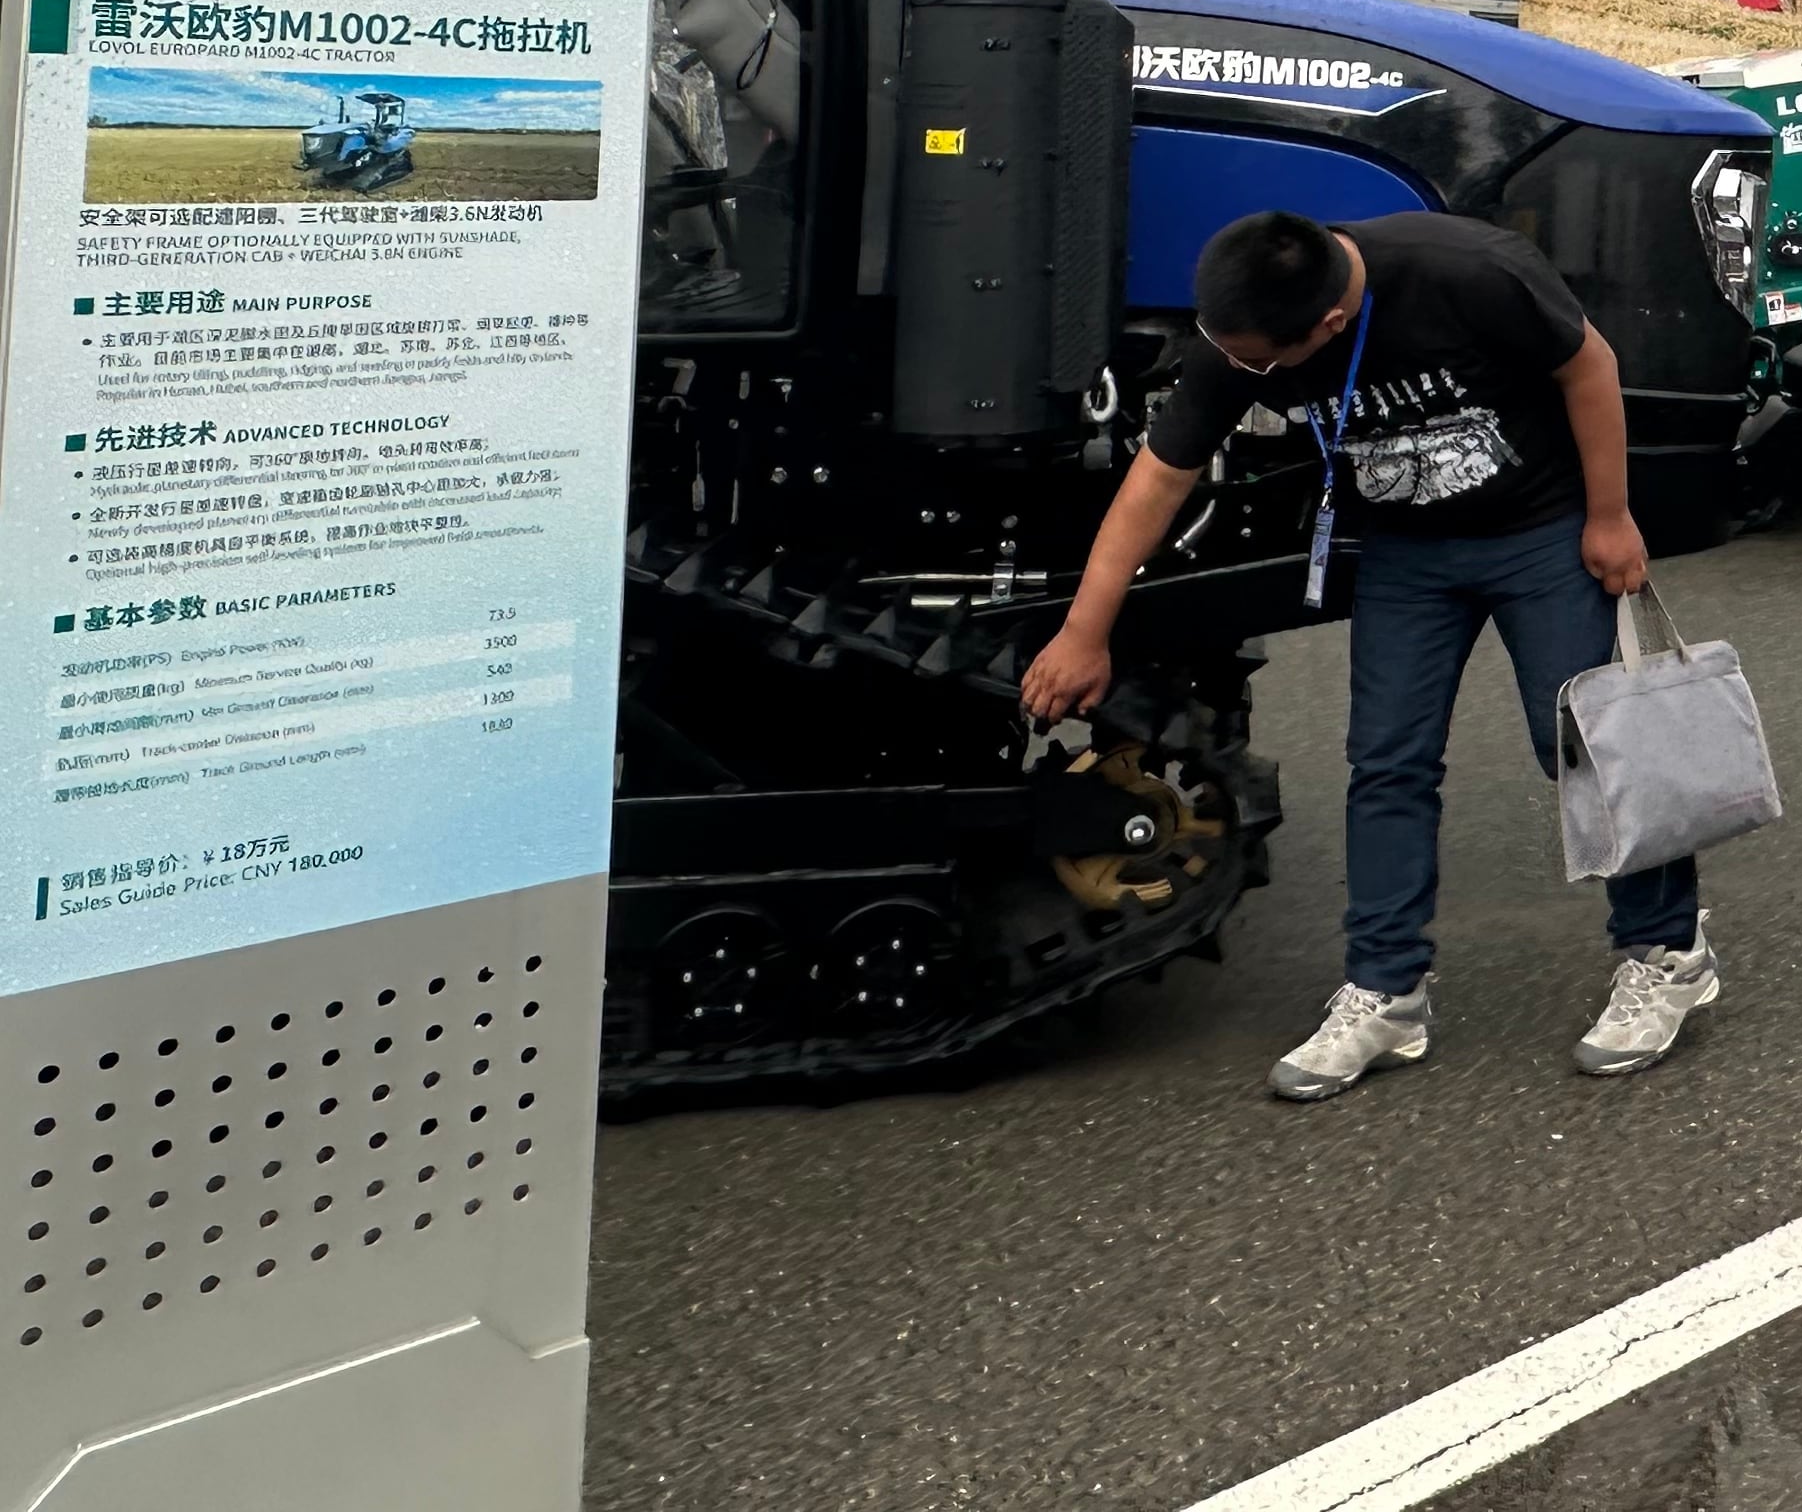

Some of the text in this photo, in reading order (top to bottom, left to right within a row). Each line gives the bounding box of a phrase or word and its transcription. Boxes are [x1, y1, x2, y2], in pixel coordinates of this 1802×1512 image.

[89, 40, 395, 63] LOVOL EUROPARD M1002-4C TRACTOR
[1133, 45, 1403, 89] 沃欧豹M1002-4C
[77, 237, 141, 250] SAFETY
[146, 236, 202, 249] FRAME
[208, 235, 309, 248] OPTIONALLY
[314, 233, 392, 247] EQUIPPED
[397, 232, 434, 245] WITH
[78, 251, 246, 266] THIRD-GENERATION
[252, 250, 283, 263] CAB
[301, 248, 366, 262] WEICHAI
[408, 246, 463, 260] ENGINE
[102, 288, 372, 316] 主要用途 MAIN PURPOSE
[95, 414, 449, 452] 先进技术 ADVANCED TECHNOLOGY
[84, 583, 396, 632] 基本参数 BASIC PARAMETERS
[59, 894, 112, 917] Sales
[118, 883, 176, 905] Guide
[242, 861, 282, 881] CNY
